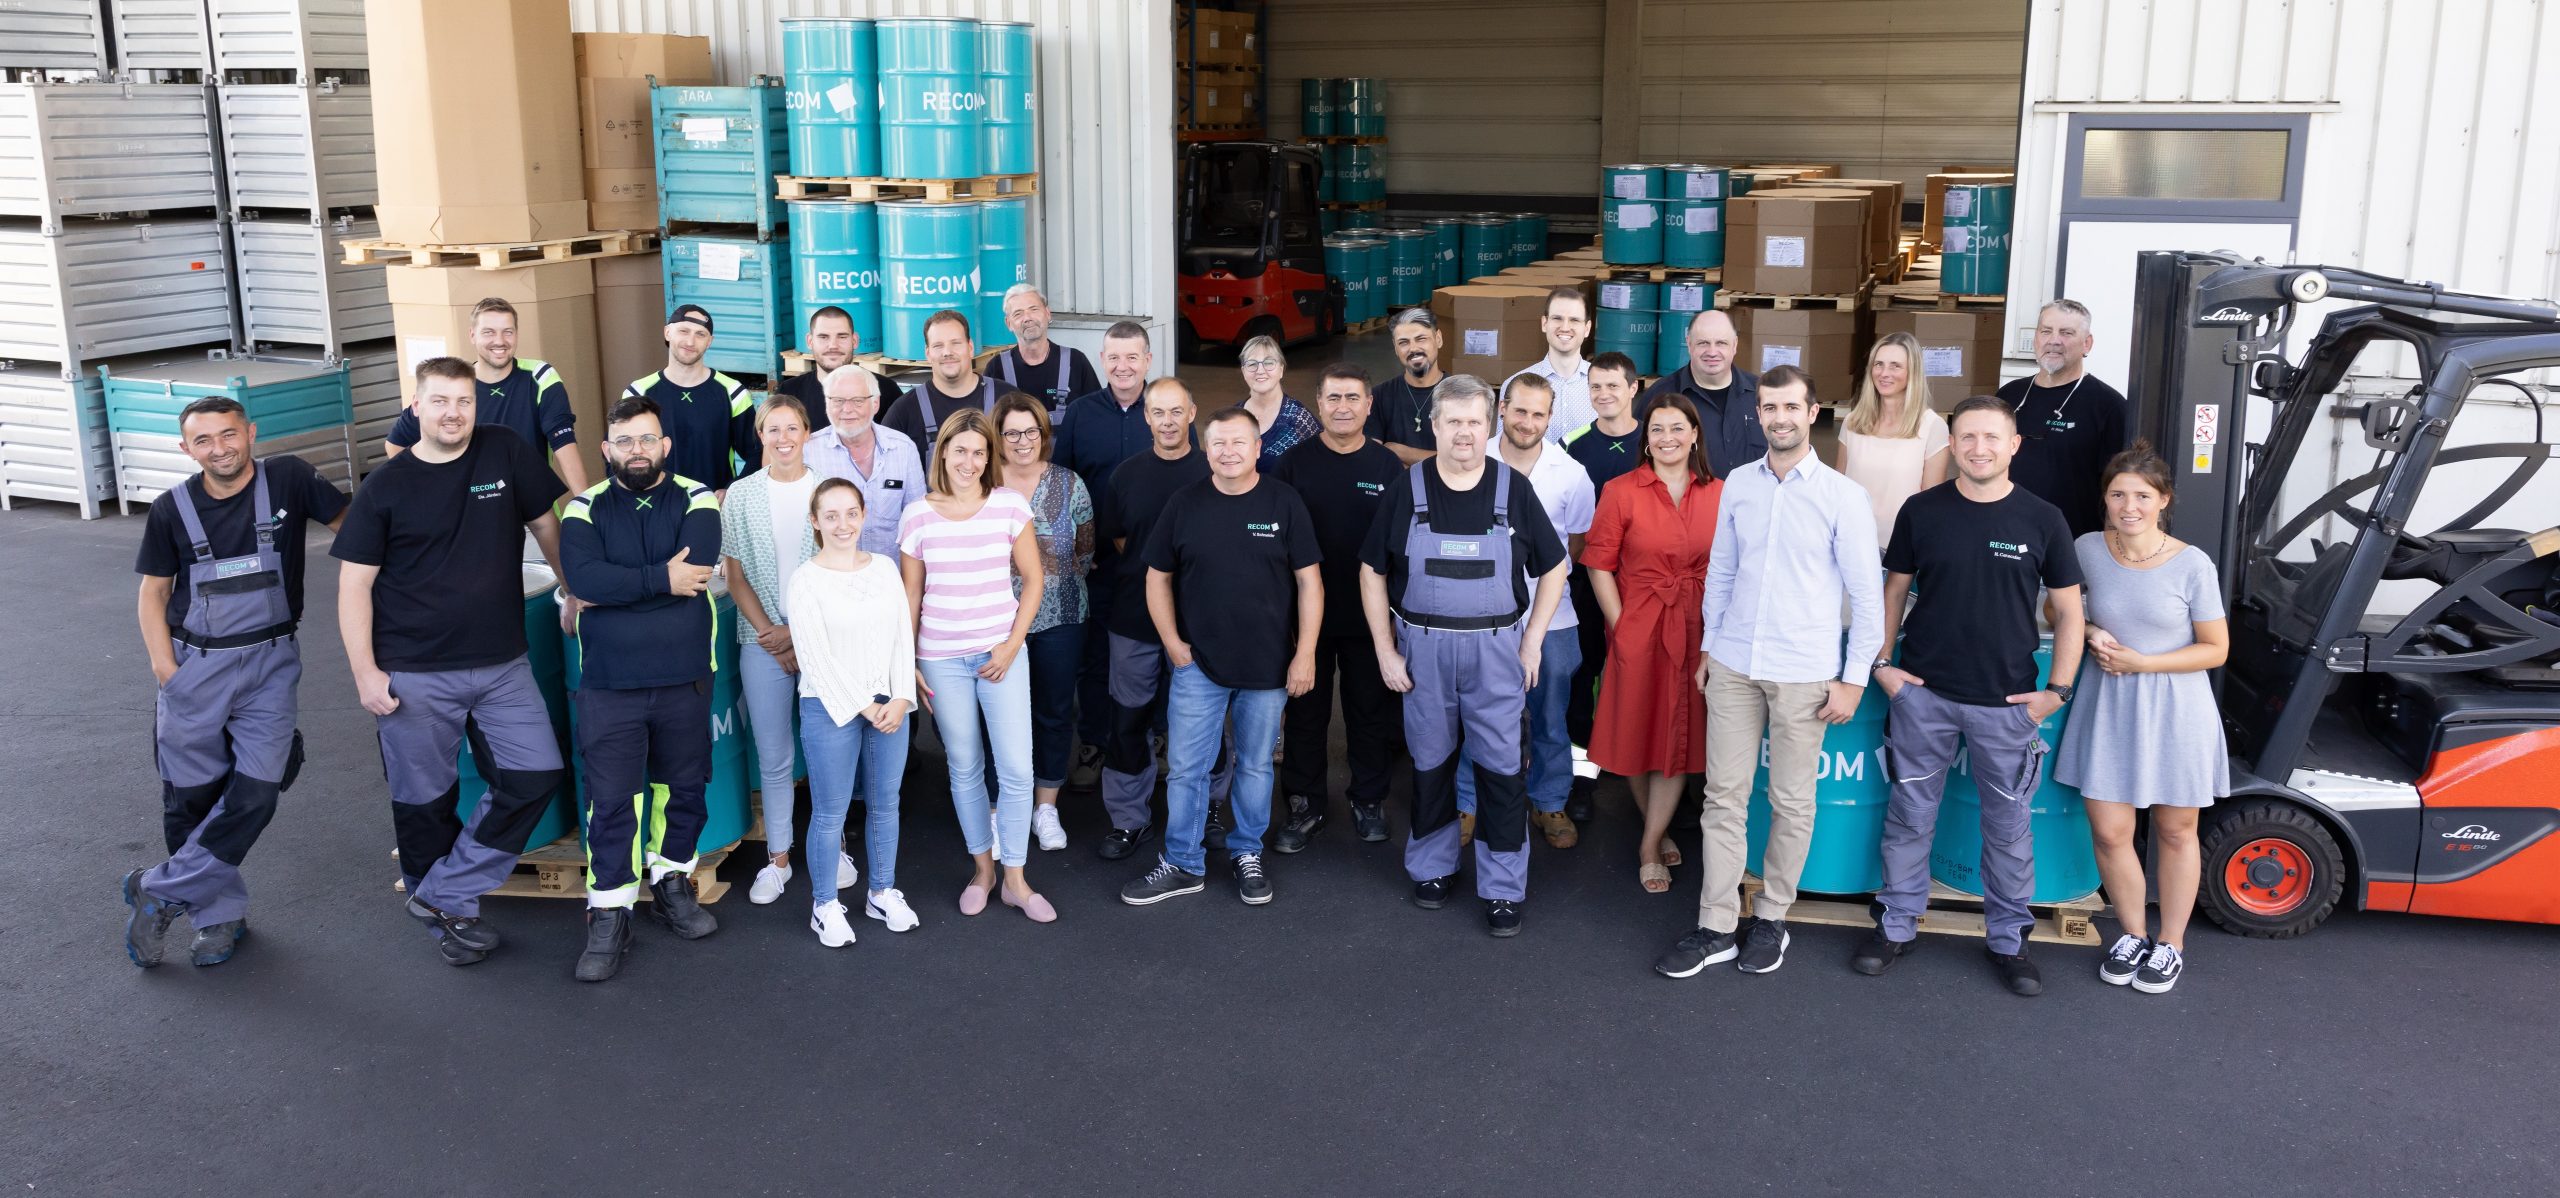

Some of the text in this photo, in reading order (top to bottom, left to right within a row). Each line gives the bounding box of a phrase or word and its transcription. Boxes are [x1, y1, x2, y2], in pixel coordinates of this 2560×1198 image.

[682, 89, 713, 102] TARA
[786, 91, 821, 110] ECOM
[922, 91, 980, 111] RECOM
[1603, 210, 1619, 223] REC
[1665, 214, 1684, 227] ECO
[1967, 235, 2000, 249] COM
[896, 275, 967, 295] RECOM
[2201, 306, 2253, 321] Linde
[1629, 323, 1657, 333] RECO
[470, 483, 496, 493] RECOM
[1357, 481, 1377, 490] RECOM
[1247, 523, 1271, 531] RECOM
[1989, 541, 2017, 551] RECOM
[2441, 824, 2501, 841] Linde
[540, 872, 559, 881] CP 3
